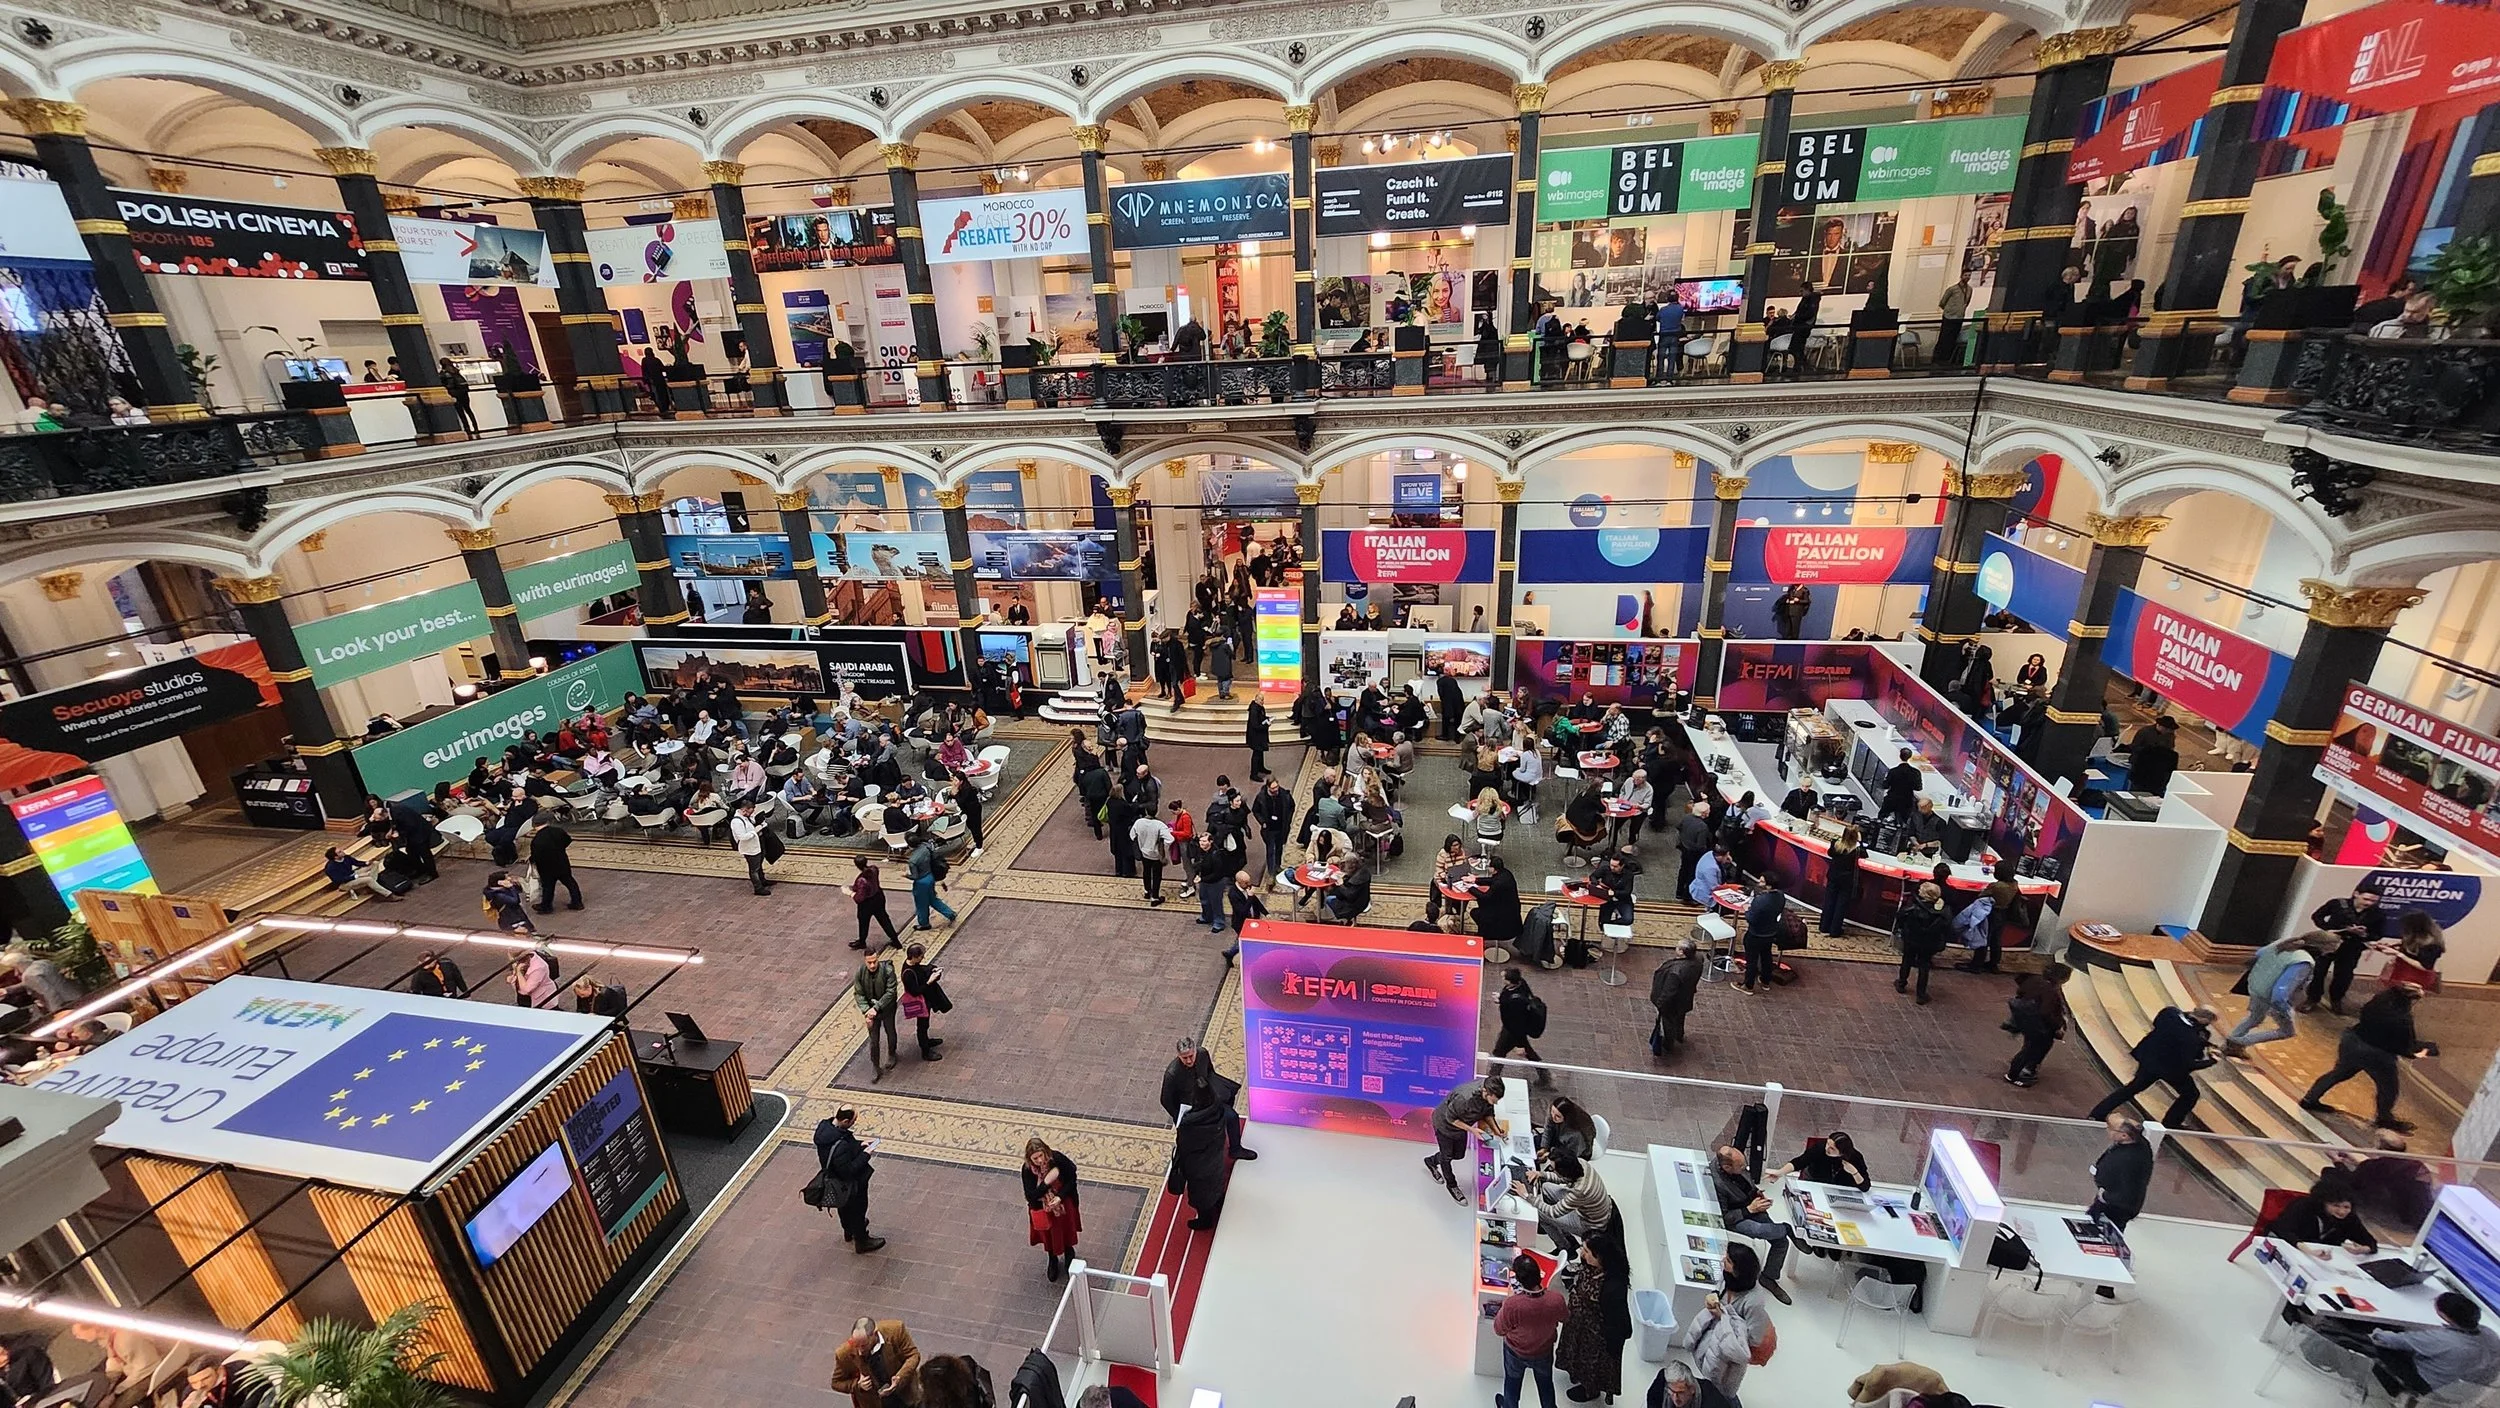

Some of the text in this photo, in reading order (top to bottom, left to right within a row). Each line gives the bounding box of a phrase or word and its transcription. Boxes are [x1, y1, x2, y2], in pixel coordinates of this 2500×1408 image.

[2350, 18, 2427, 85] SEE NL
[2122, 100, 2164, 145] SEE NL
[1799, 133, 1854, 157] BEL
[1621, 148, 1673, 171] BEL
[1950, 148, 2012, 164] flanders
[1690, 166, 1746, 182] flanders
[1795, 157, 1828, 179] GI
[1867, 165, 1932, 180] wbimages
[1964, 160, 2010, 175] image
[1385, 175, 1439, 191] Czech It.
[1619, 171, 1650, 192] GI
[1703, 177, 1745, 193] image
[1547, 187, 1605, 202] wbimages
[1793, 179, 1840, 201] UM
[983, 199, 1035, 212] MOROCCO
[1160, 193, 1284, 216] MNEMONICA
[1386, 191, 1430, 206] Fund It.
[1618, 192, 1662, 213] UM
[117, 201, 340, 238] POLISH CINEMA
[976, 213, 1010, 229] CASH
[1160, 212, 1253, 226] SCREEN. DELIVER. PRESERVE.
[1385, 207, 1430, 221] Create.
[393, 225, 419, 236] YOUR
[959, 207, 1071, 247] REBATE 30%
[131, 232, 215, 248] BOOTH 185
[396, 235, 418, 245] OUR
[1012, 241, 1053, 253] WITH NO CAP
[1539, 231, 1566, 247] BEL
[1538, 258, 1561, 269] UM
[1364, 535, 1426, 548] ITALIAN
[1785, 532, 1859, 546] ITALIAN
[1376, 548, 1450, 561] PAVILION
[1797, 547, 1884, 561] PAVILION
[516, 560, 628, 604] with eurimages!
[1801, 570, 1818, 578] EFM
[315, 609, 477, 665] Look your best...
[2153, 613, 2221, 658] ITALIAN
[829, 662, 894, 672] SAUDI ARABIA
[1754, 663, 1793, 680] EFM
[1803, 666, 1852, 675] SPAIN
[2159, 637, 2243, 692] PAVILION
[547, 673, 571, 687] COUNCIL
[579, 663, 598, 675] EUROPE
[2158, 673, 2174, 690] EFM
[52, 671, 204, 722] Secuoya studios
[60, 685, 208, 733] Where great stories come to life
[1899, 694, 1919, 727] EFM
[2349, 690, 2435, 737] GERMAN
[86, 734, 103, 744] Find
[117, 726, 130, 735] the
[129, 720, 154, 731] Cinema
[154, 714, 169, 724] from
[422, 704, 547, 769] eurimages
[2329, 743, 2351, 758] WHAT
[2375, 765, 2403, 785] YUNAN
[246, 800, 290, 811] eurimages
[2421, 797, 2472, 827] THE WORLD
[2424, 790, 2471, 818] PUNCHING
[2374, 876, 2444, 889] ITALIAN
[2383, 887, 2465, 900] PAVILION
[1304, 976, 1357, 1000] EFM
[1371, 983, 1437, 999] SPAIN
[1371, 996, 1398, 1004] COUNTRY
[231, 995, 365, 1032] MEDIA
[1362, 1031, 1425, 1043] Meet the Spanish
[1362, 1038, 1403, 1048] delegation!
[129, 1031, 298, 1081] Europe
[40, 1069, 227, 1123] Creative
[571, 1092, 622, 1145] SUPPORTED
[575, 1126, 606, 1158] FILMS
